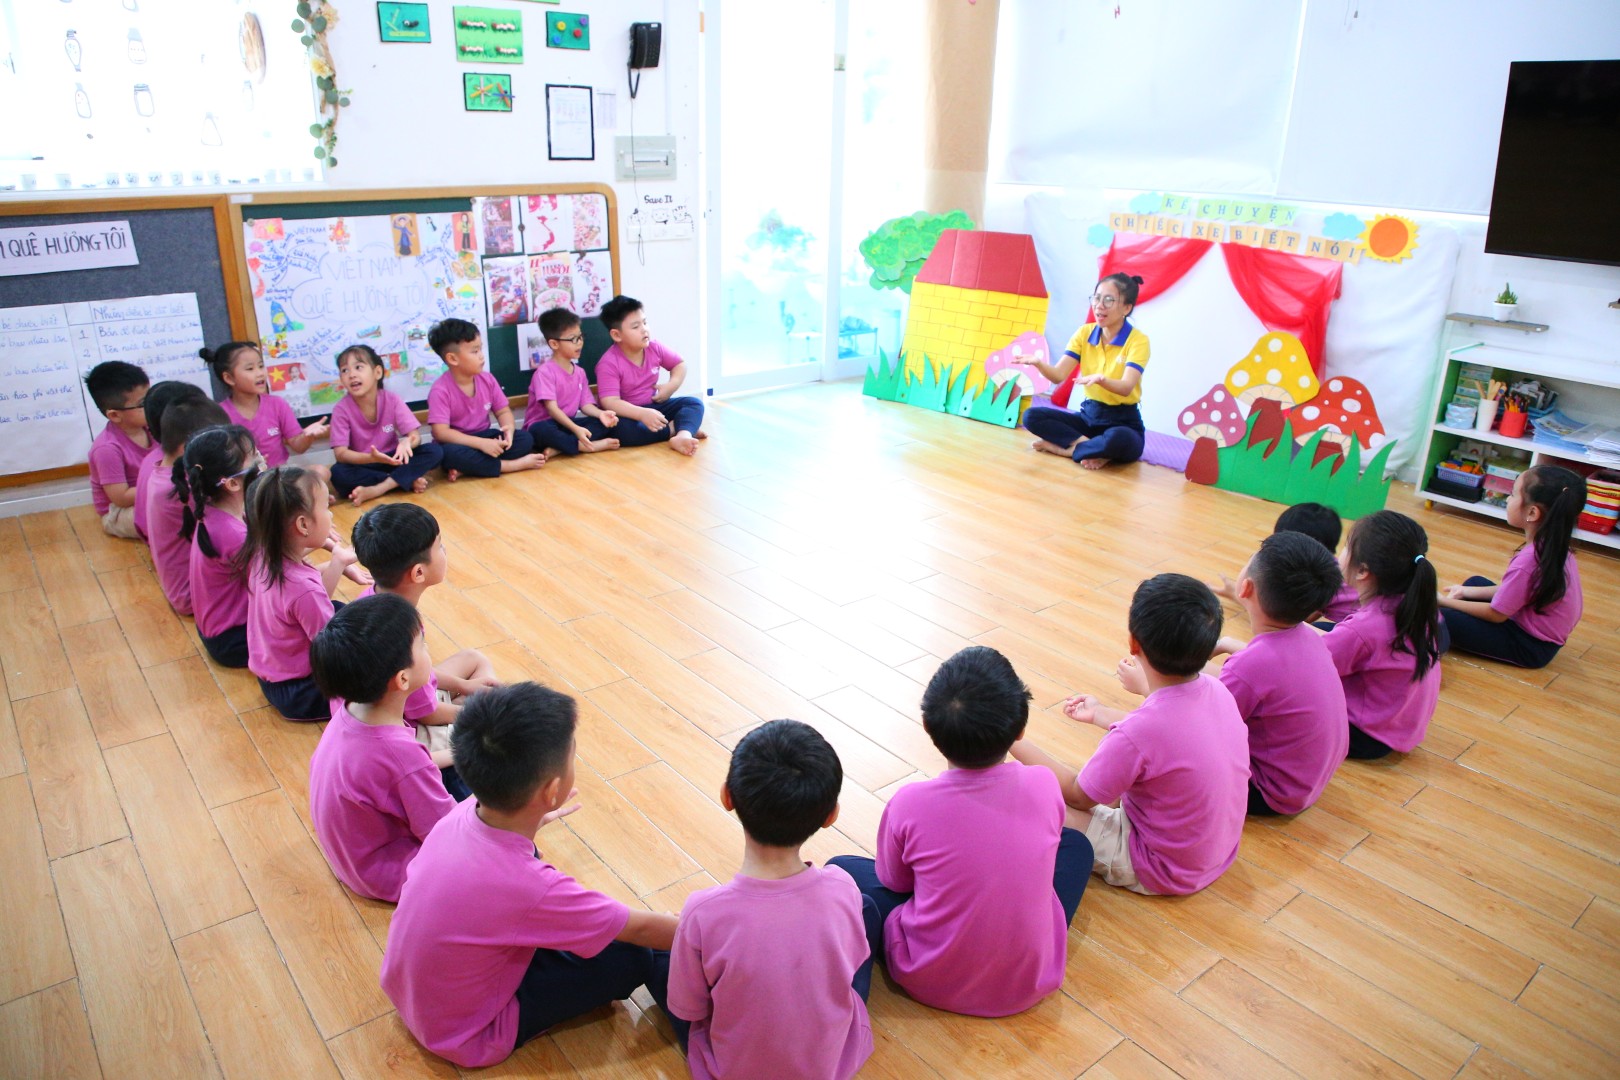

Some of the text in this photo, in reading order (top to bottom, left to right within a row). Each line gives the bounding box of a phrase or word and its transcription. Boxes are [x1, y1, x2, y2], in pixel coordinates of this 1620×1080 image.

[643, 194, 664, 204] Save
[1202, 203, 1295, 223] CHUYỆN
[8, 231, 40, 257] QUÊ
[100, 226, 127, 250] TÔI
[1195, 225, 1220, 238] XE
[1311, 241, 1354, 258] NÓI
[369, 256, 403, 279] NAM
[303, 287, 334, 314] QUÊ
[79, 329, 89, 340] 1
[83, 348, 91, 358] 2
